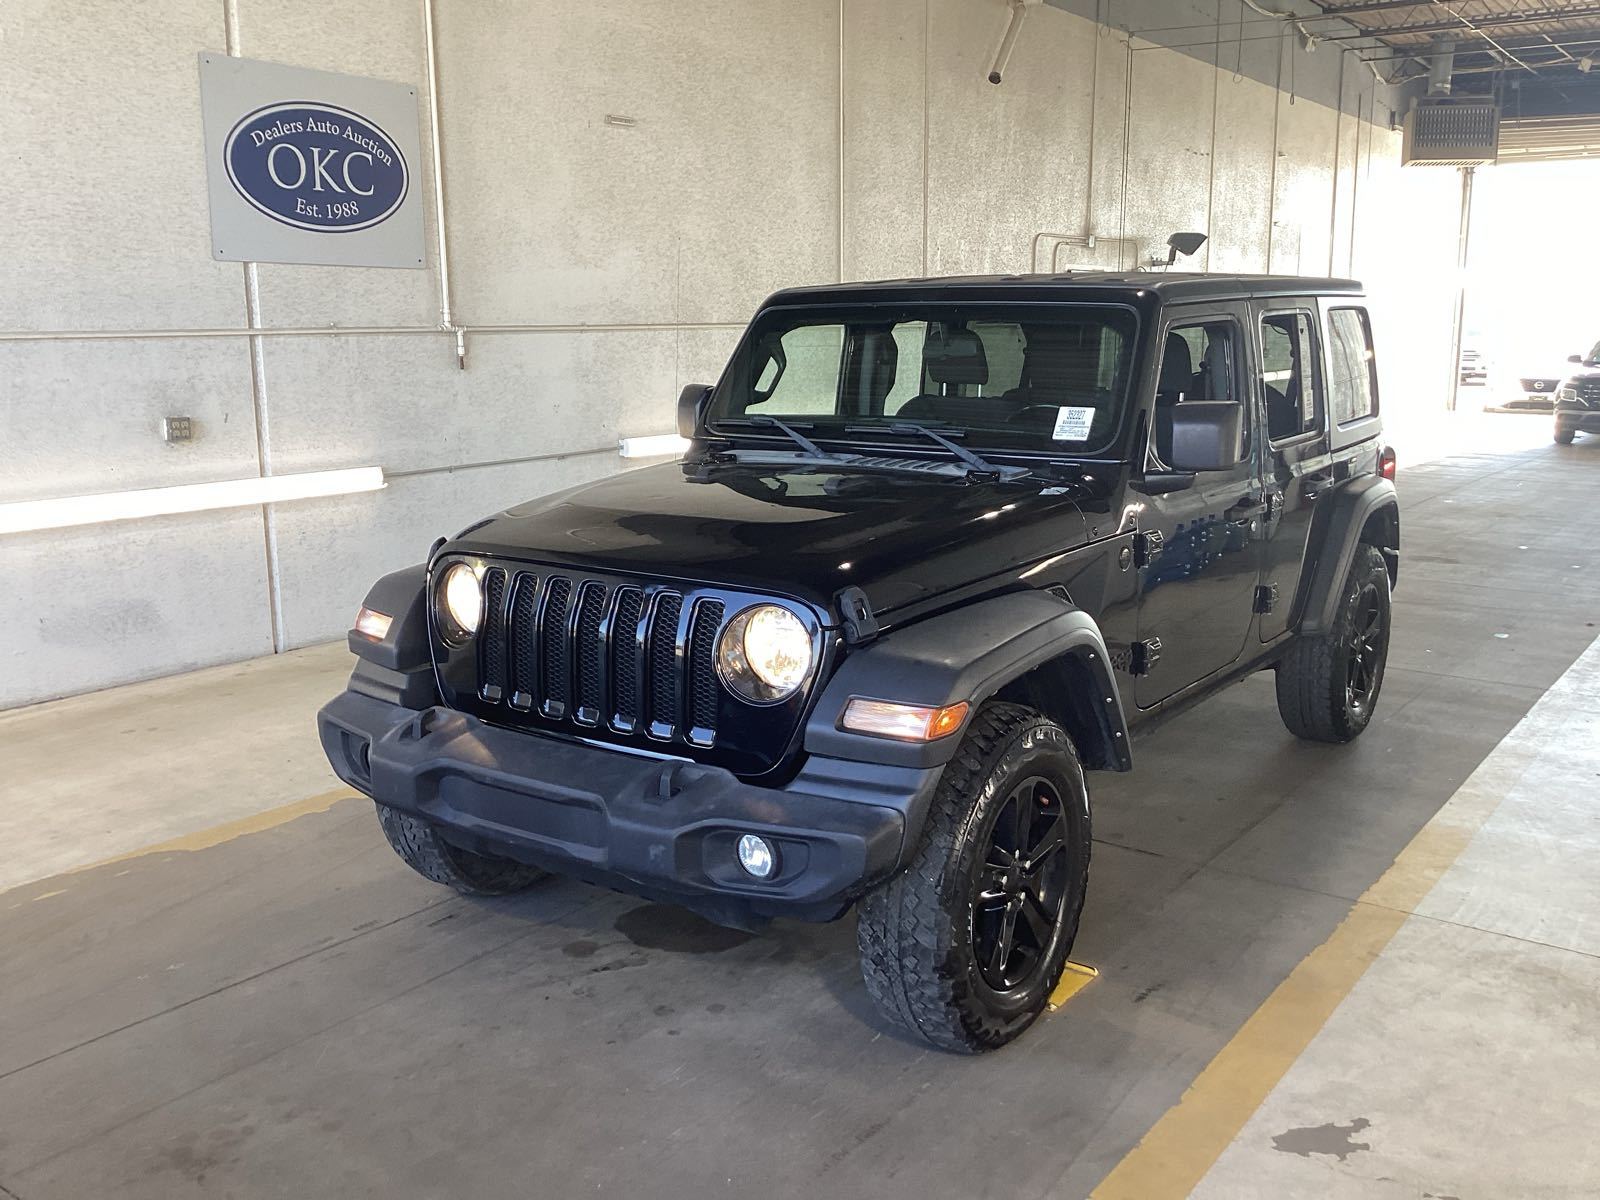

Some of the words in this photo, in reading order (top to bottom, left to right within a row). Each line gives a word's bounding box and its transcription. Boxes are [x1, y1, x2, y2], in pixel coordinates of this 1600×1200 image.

[250, 120, 303, 147] Dealers
[306, 117, 340, 136] Auto
[342, 126, 392, 167] Auction
[267, 143, 375, 196] OKC
[295, 198, 322, 218] Est.
[326, 200, 359, 219] 1988
